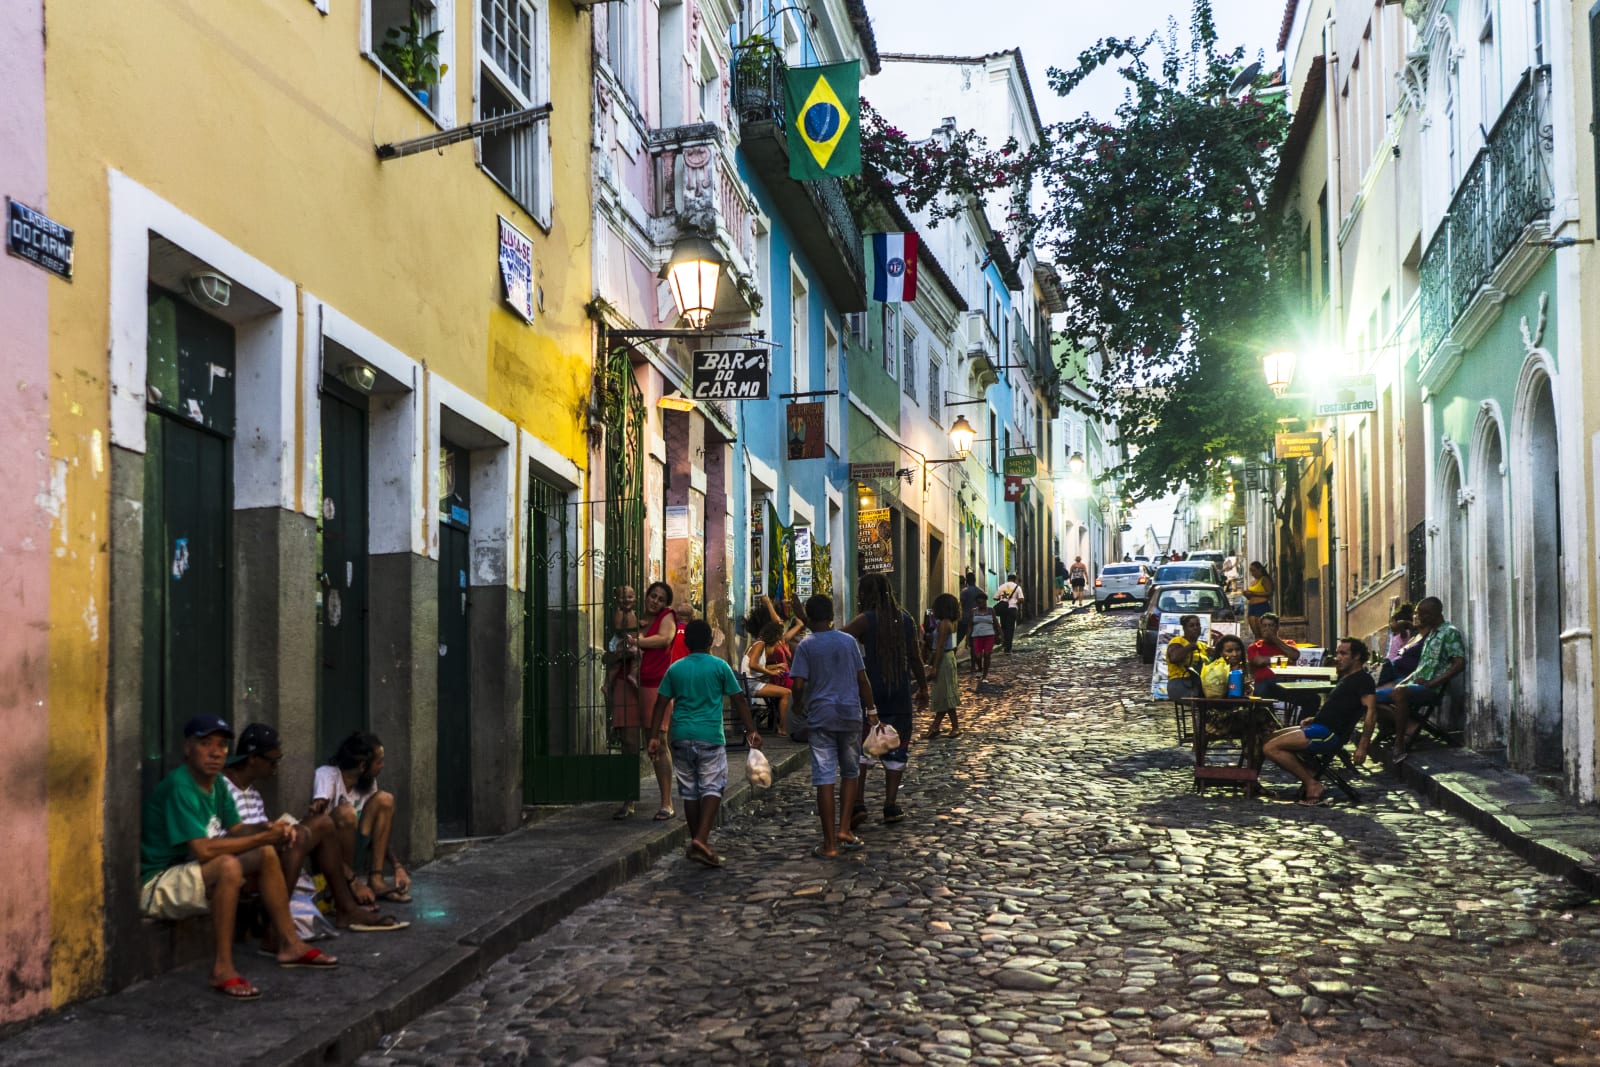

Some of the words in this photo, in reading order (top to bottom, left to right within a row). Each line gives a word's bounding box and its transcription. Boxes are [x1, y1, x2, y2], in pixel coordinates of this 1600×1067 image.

[20, 207, 66, 241] LADEIRA
[12, 219, 31, 244] DO
[32, 229, 73, 265] CARMO
[697, 352, 745, 370] BAR
[714, 370, 735, 381] DO
[695, 381, 760, 398] CARMO
[1319, 399, 1374, 413] restaurante
